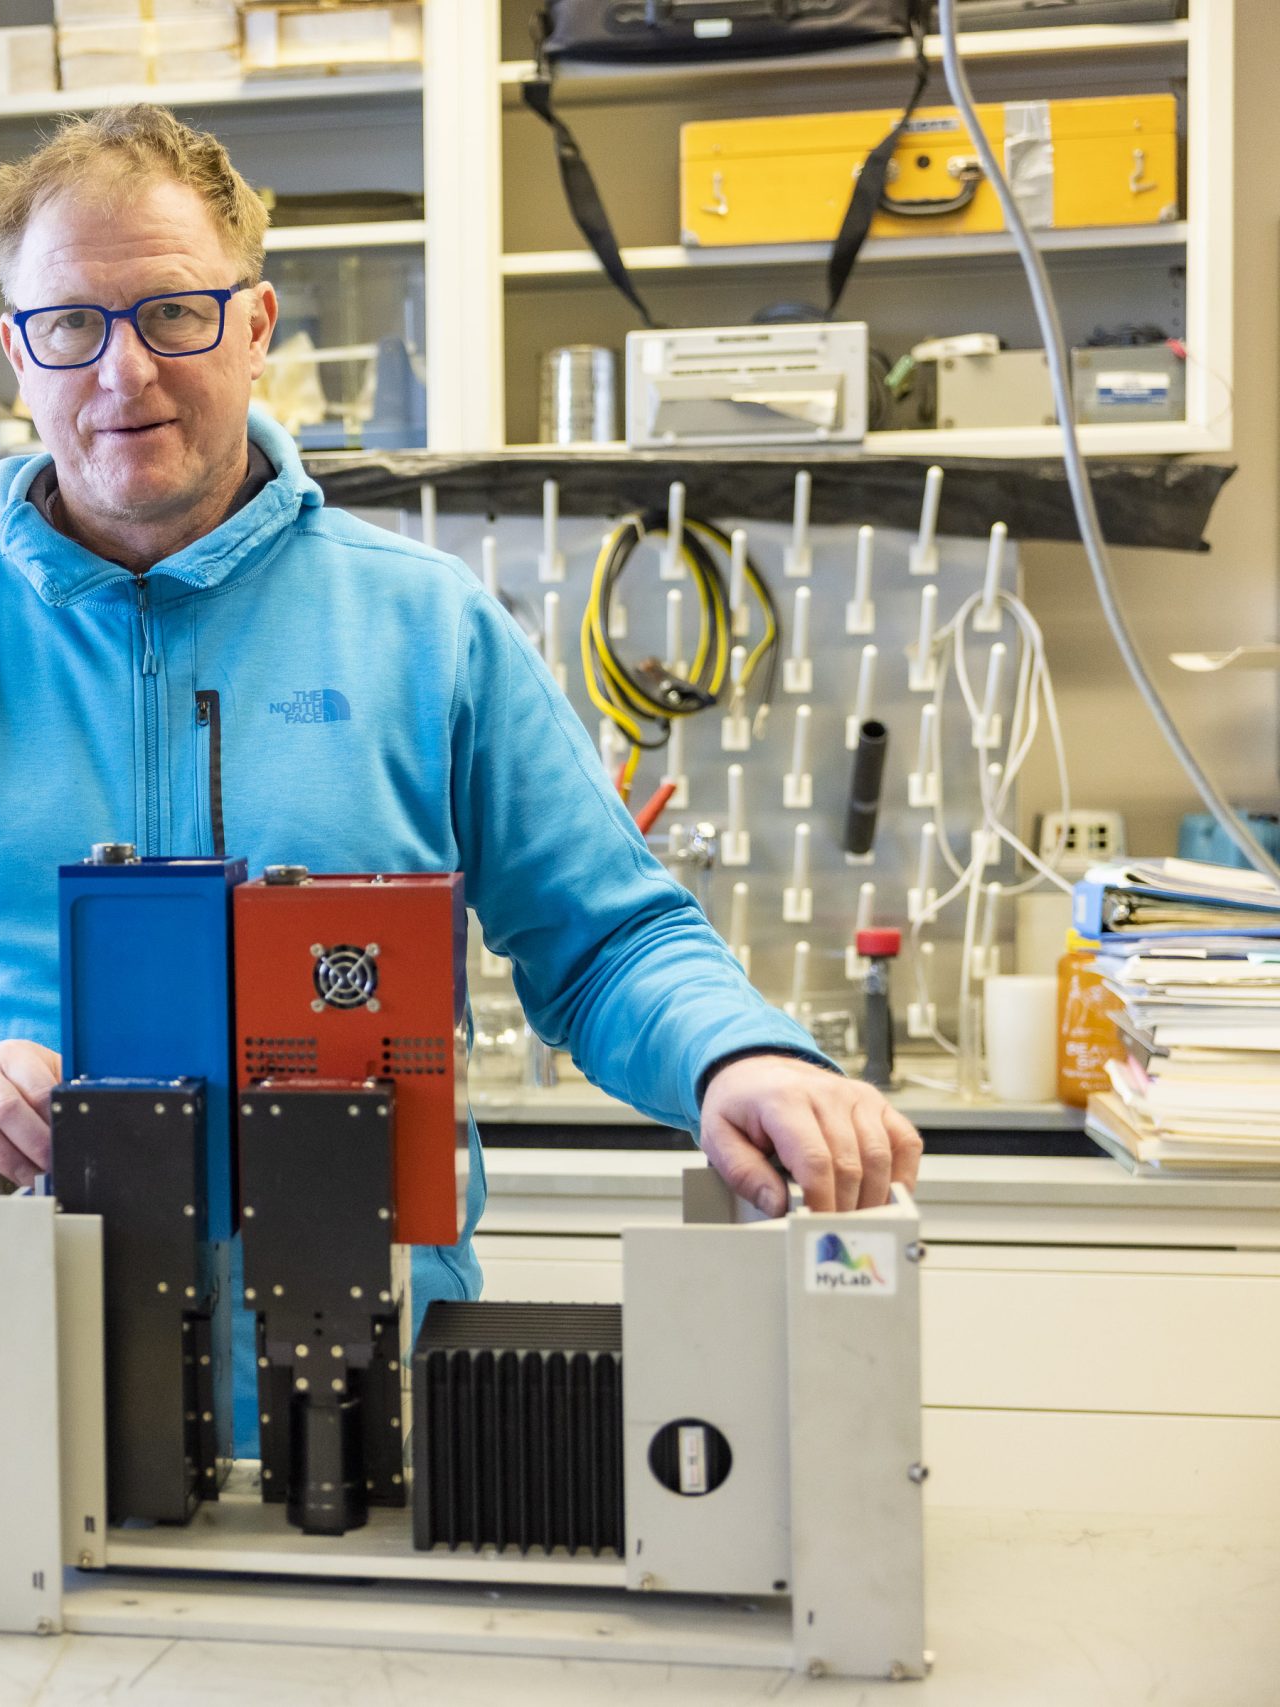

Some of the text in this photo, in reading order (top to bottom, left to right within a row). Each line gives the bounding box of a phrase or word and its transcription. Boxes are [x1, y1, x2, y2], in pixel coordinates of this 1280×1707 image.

[293, 690, 322, 702] THE
[270, 701, 322, 714] NORTH
[285, 712, 322, 724] FACE
[816, 1273, 871, 1288] HyLab
